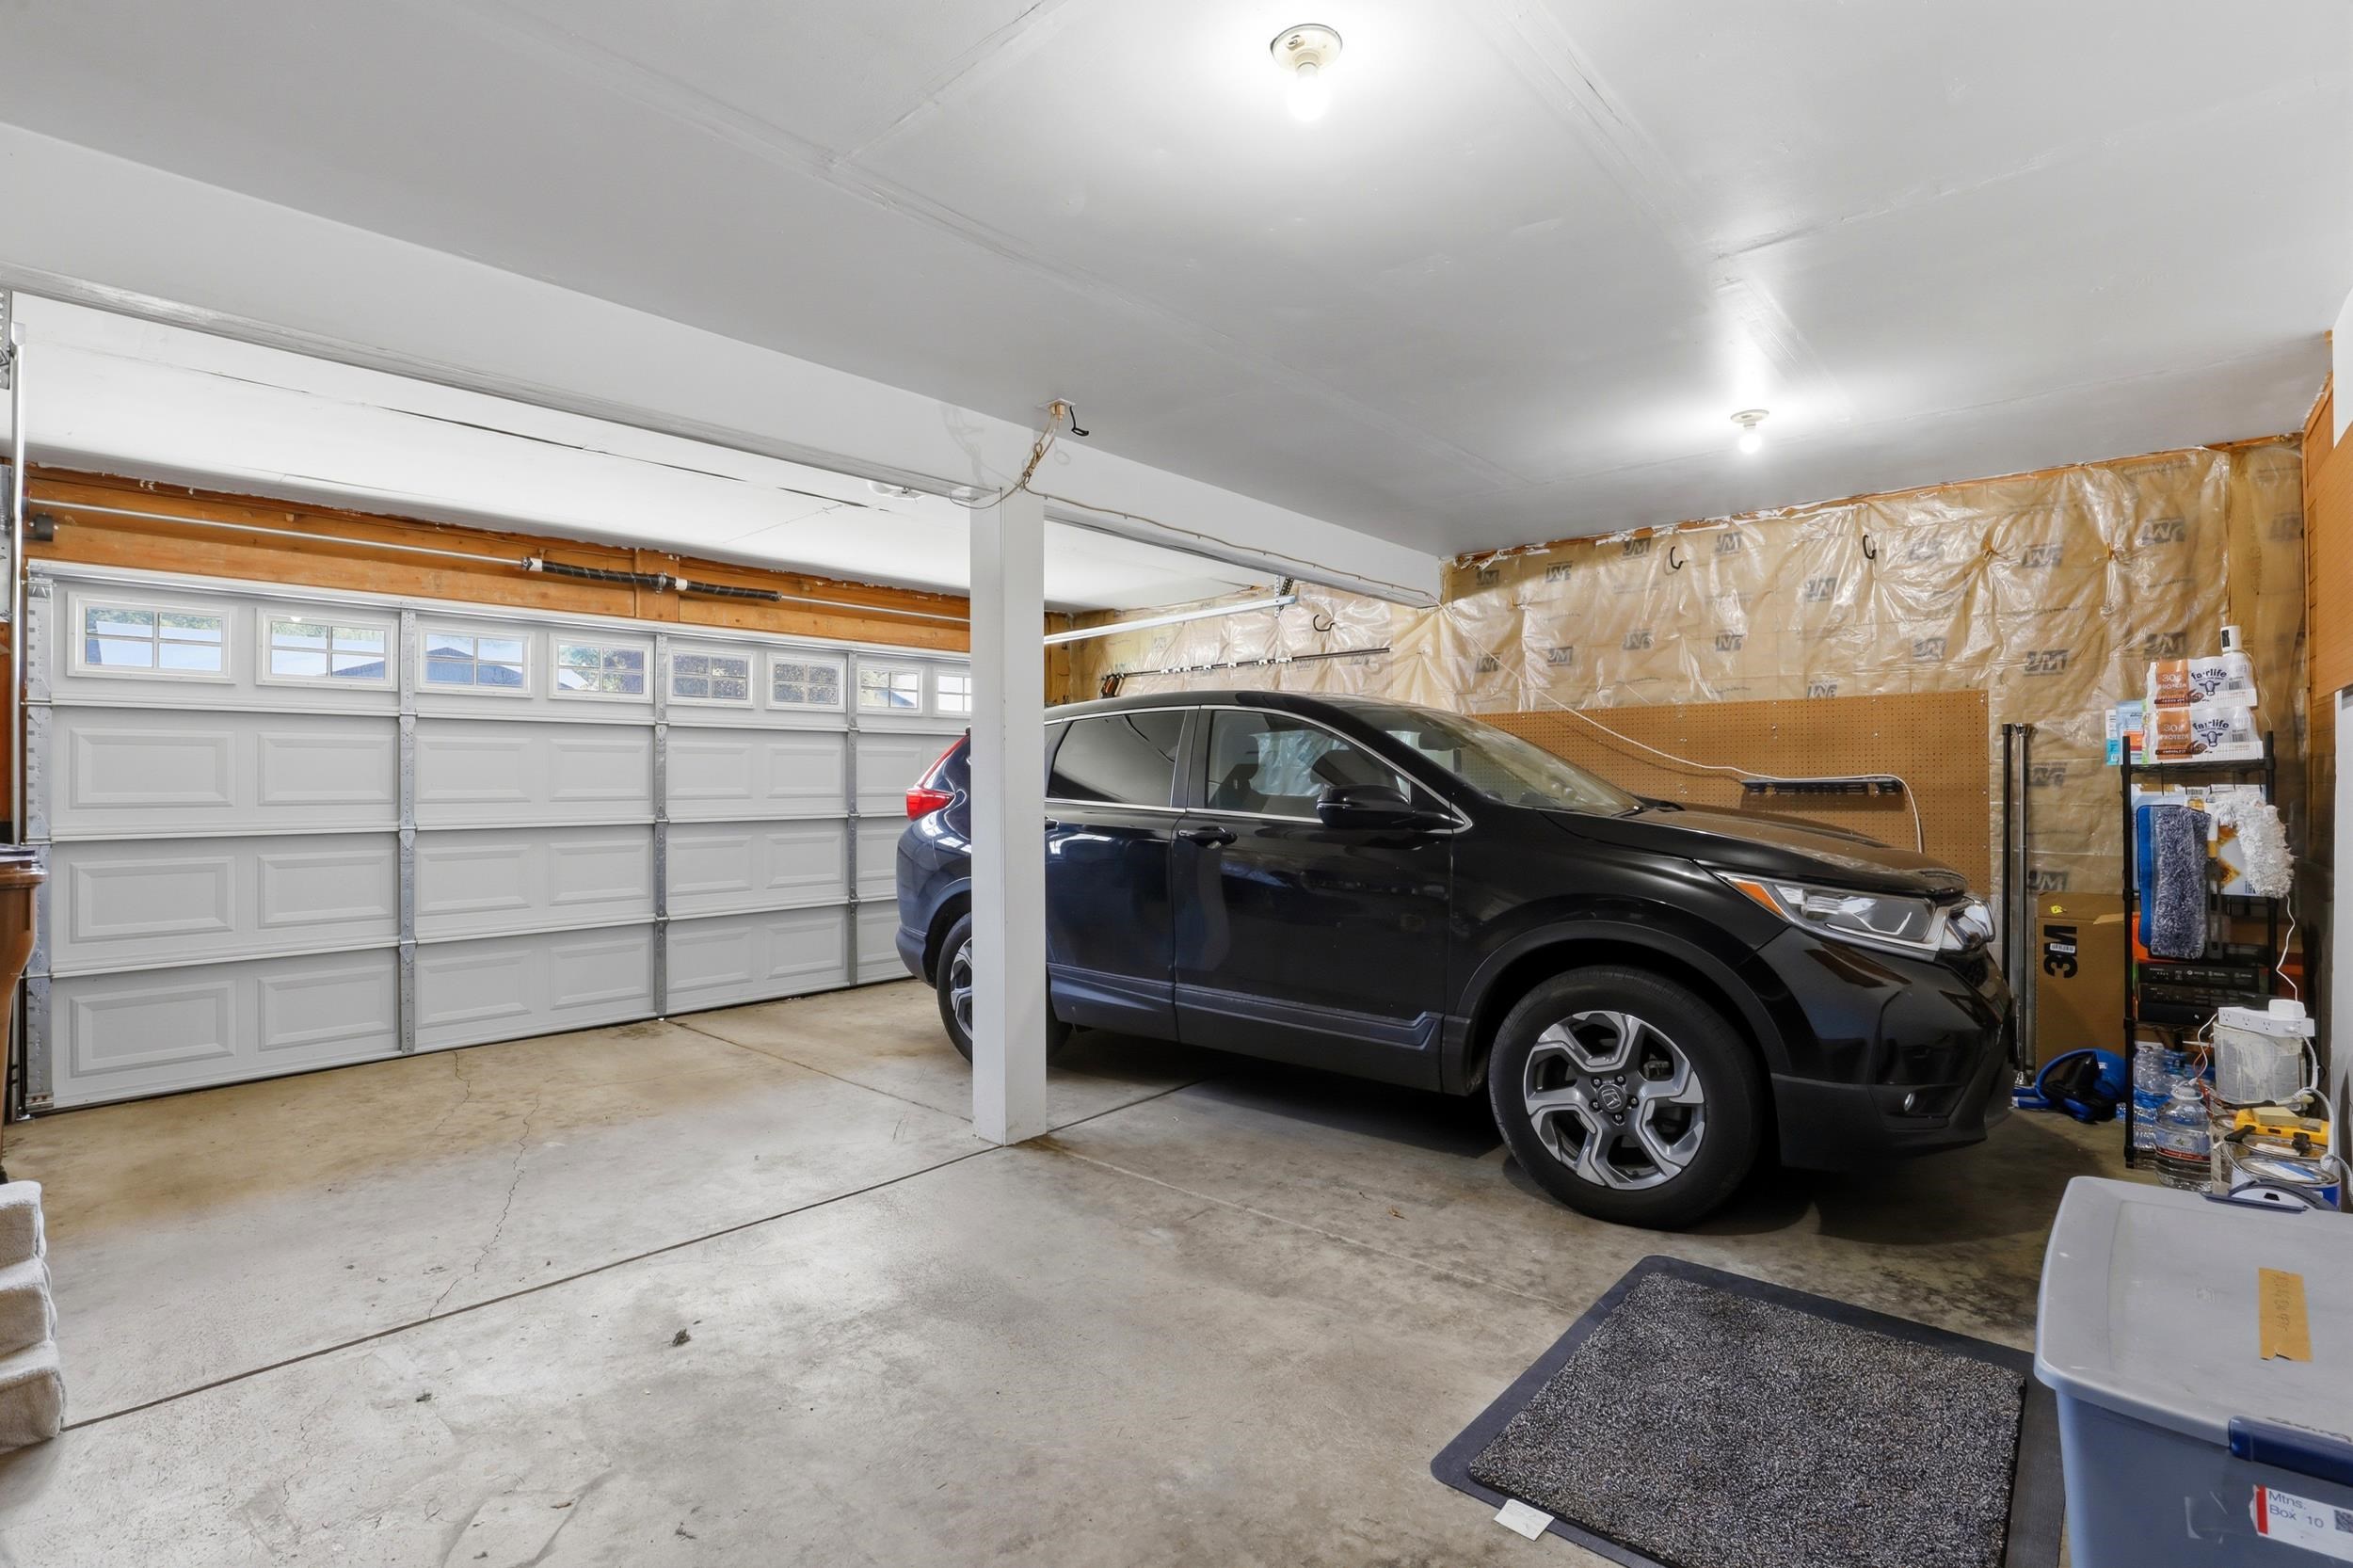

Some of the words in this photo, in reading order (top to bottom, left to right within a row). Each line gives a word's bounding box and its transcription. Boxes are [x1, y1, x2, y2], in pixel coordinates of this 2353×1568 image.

[2029, 872, 2068, 890] JM
[2044, 925, 2077, 978] 3M
[2268, 1490, 2306, 1510] Mtns.
[2269, 1505, 2297, 1521] Box
[2306, 1515, 2324, 1528] 10
